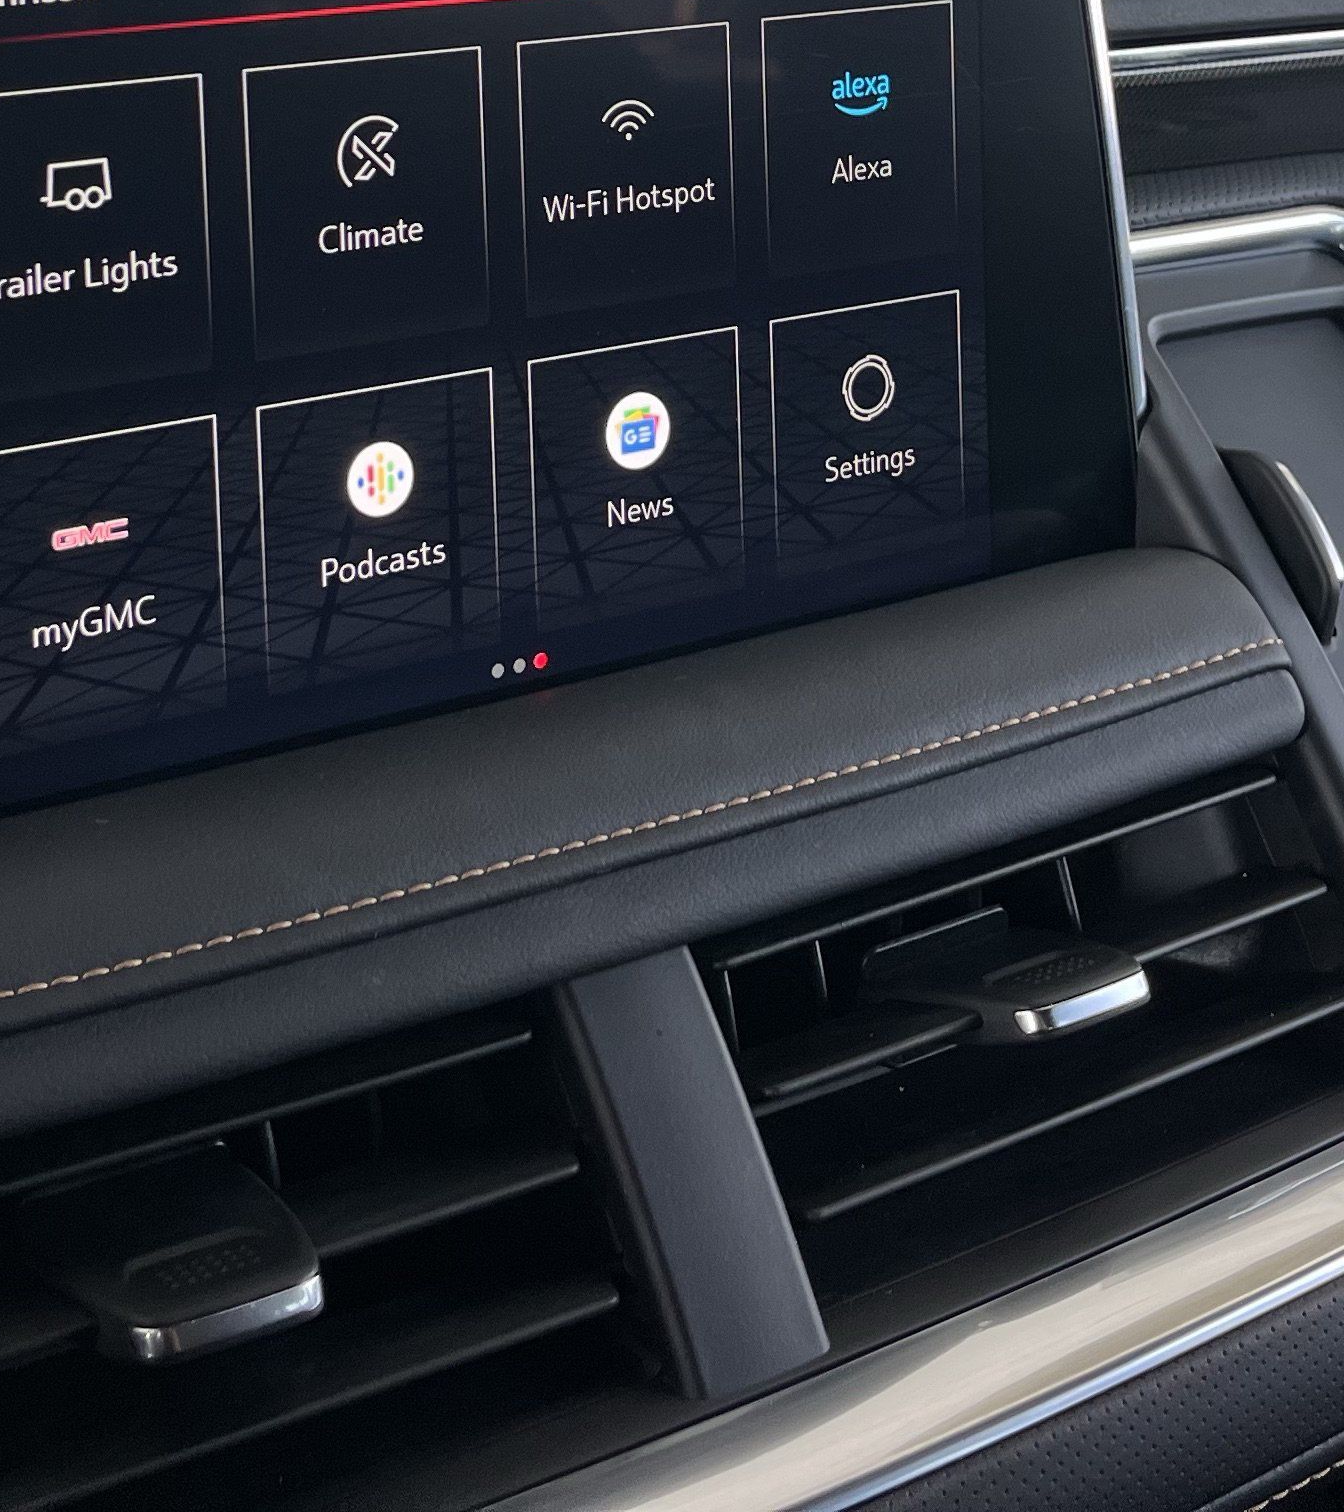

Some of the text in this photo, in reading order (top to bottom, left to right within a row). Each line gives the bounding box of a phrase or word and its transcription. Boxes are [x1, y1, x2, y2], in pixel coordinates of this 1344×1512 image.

[831, 71, 890, 101] alexa
[831, 154, 893, 185] Alexa
[542, 177, 716, 223] Wi-Fi Hotspot
[318, 218, 424, 254] Climate
[84, 249, 179, 293] Lights
[824, 448, 916, 483] Settings
[607, 497, 674, 528] News
[51, 517, 129, 552] GMC
[320, 539, 447, 588] Podcasts
[32, 594, 157, 652] myGMC
